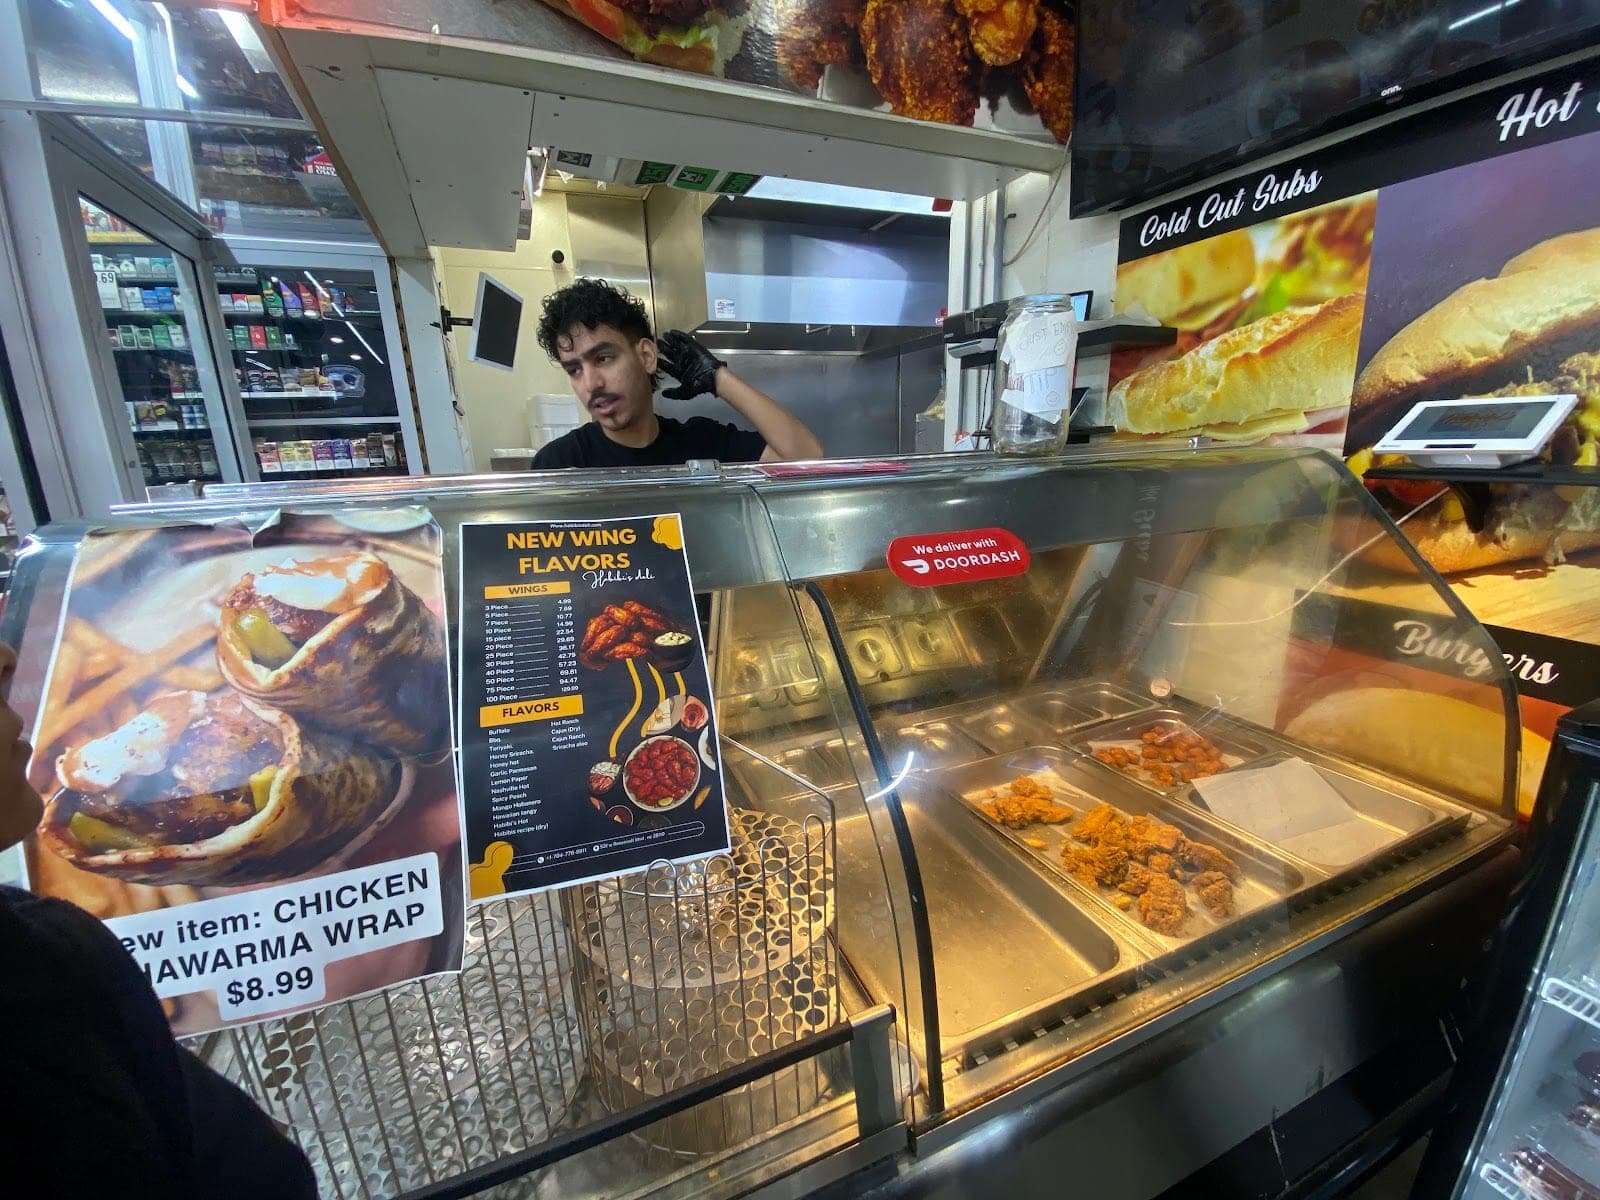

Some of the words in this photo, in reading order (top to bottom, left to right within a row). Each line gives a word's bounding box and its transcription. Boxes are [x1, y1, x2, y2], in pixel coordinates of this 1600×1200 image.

[1380, 84, 1402, 96] onn.
[1496, 82, 1584, 142] Hot
[1140, 207, 1191, 247] Cold
[1198, 189, 1245, 228] Cut
[1254, 168, 1322, 211] Subs
[507, 531, 565, 549] NEW
[569, 528, 637, 547] WING
[912, 545, 933, 554] We
[935, 542, 972, 553] deliver
[973, 538, 997, 548] with
[519, 552, 630, 574] FLAVORS
[934, 550, 1020, 570] DOORDASH
[509, 585, 548, 595] WINGS
[503, 702, 559, 717] FLAVORS
[509, 765, 537, 774] Parmesan
[491, 786, 518, 794] Nashville
[120, 930, 164, 954] ew
[176, 909, 261, 944] item:
[274, 868, 429, 924] CHICKEN
[323, 902, 425, 948] WRAP
[227, 966, 314, 1007] $8.99
